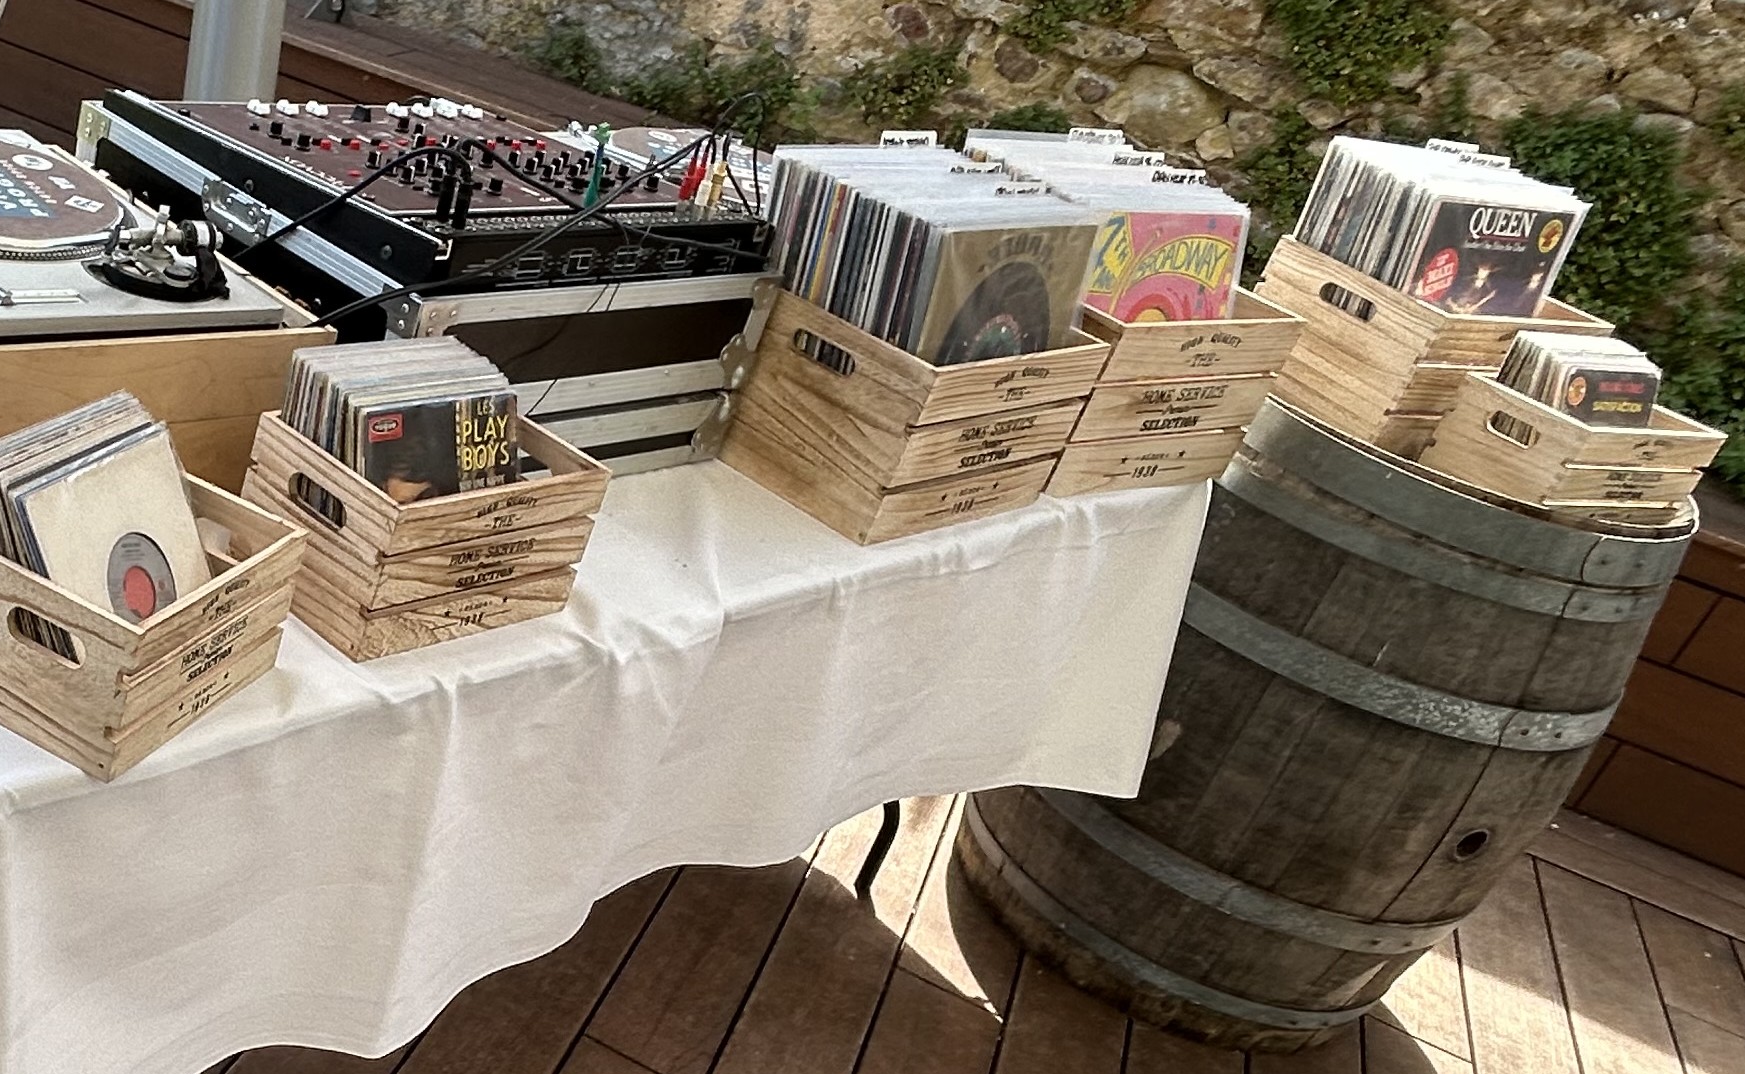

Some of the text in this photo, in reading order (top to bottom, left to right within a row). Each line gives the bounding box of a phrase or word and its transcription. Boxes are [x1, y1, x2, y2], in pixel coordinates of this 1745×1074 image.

[1469, 207, 1538, 239] QUEEN
[462, 414, 509, 444] PLAY
[1140, 416, 1200, 431] SELECTION
[462, 441, 510, 471] BOYS
[455, 566, 516, 588] SELECTION
